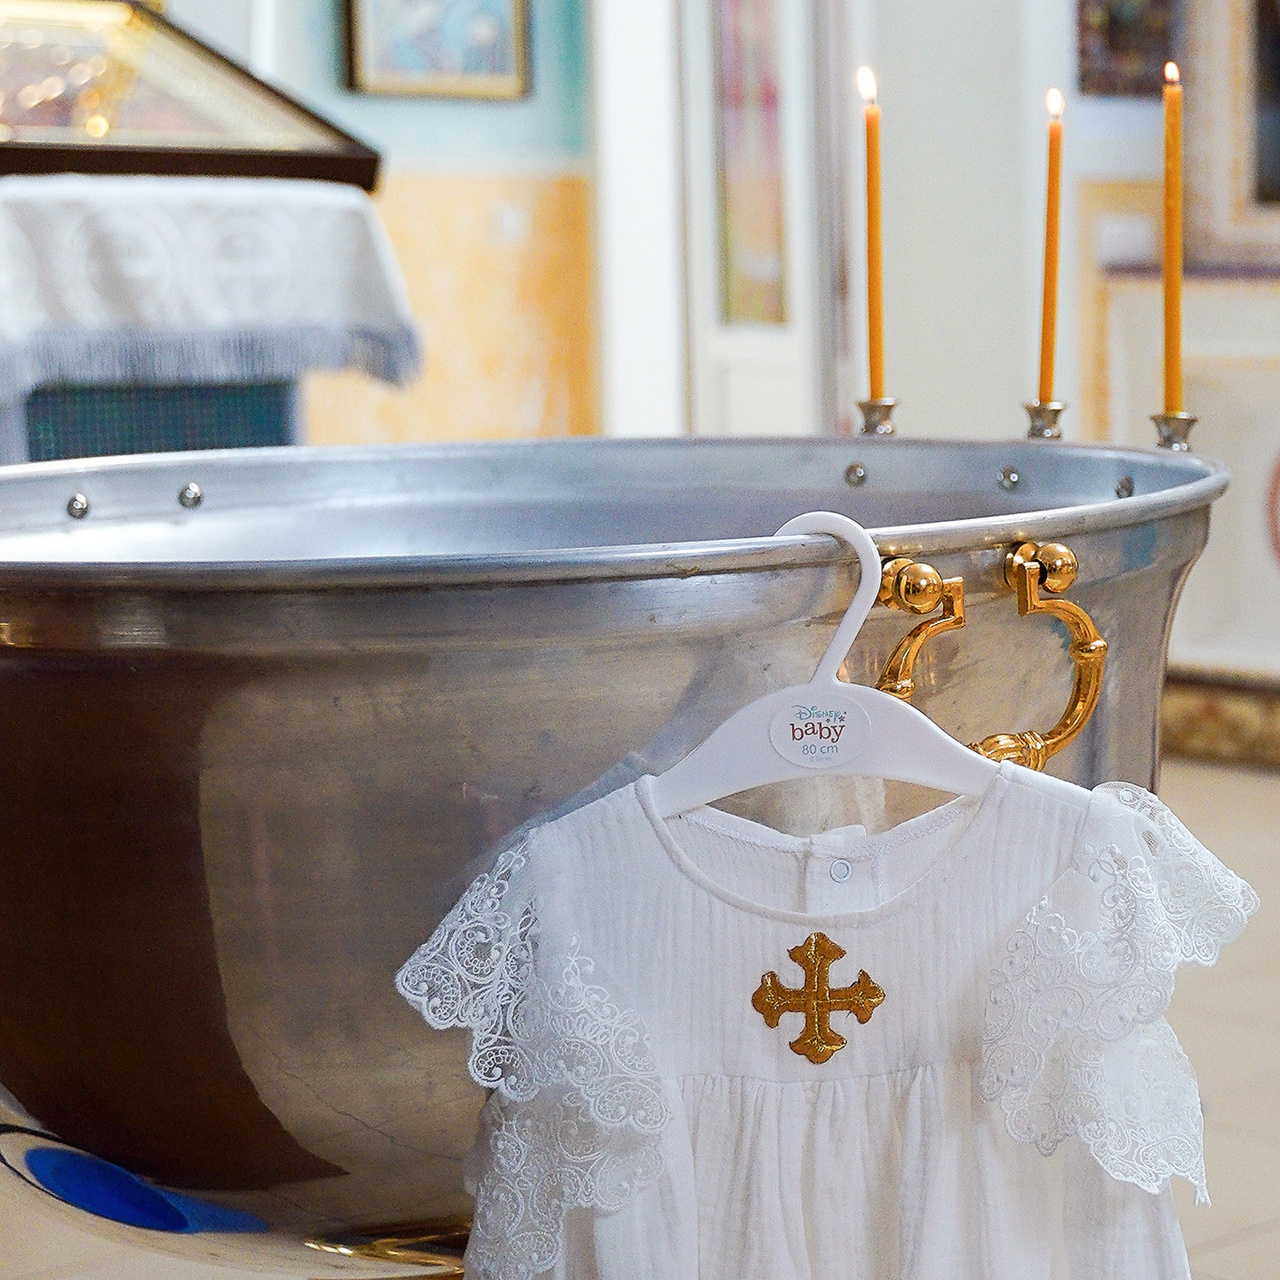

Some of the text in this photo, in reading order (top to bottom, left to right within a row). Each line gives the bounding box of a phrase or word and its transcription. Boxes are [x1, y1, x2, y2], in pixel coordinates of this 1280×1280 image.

[791, 704, 841, 723] Disney
[789, 721, 846, 743] baby
[802, 744, 839, 755] 80 cm
